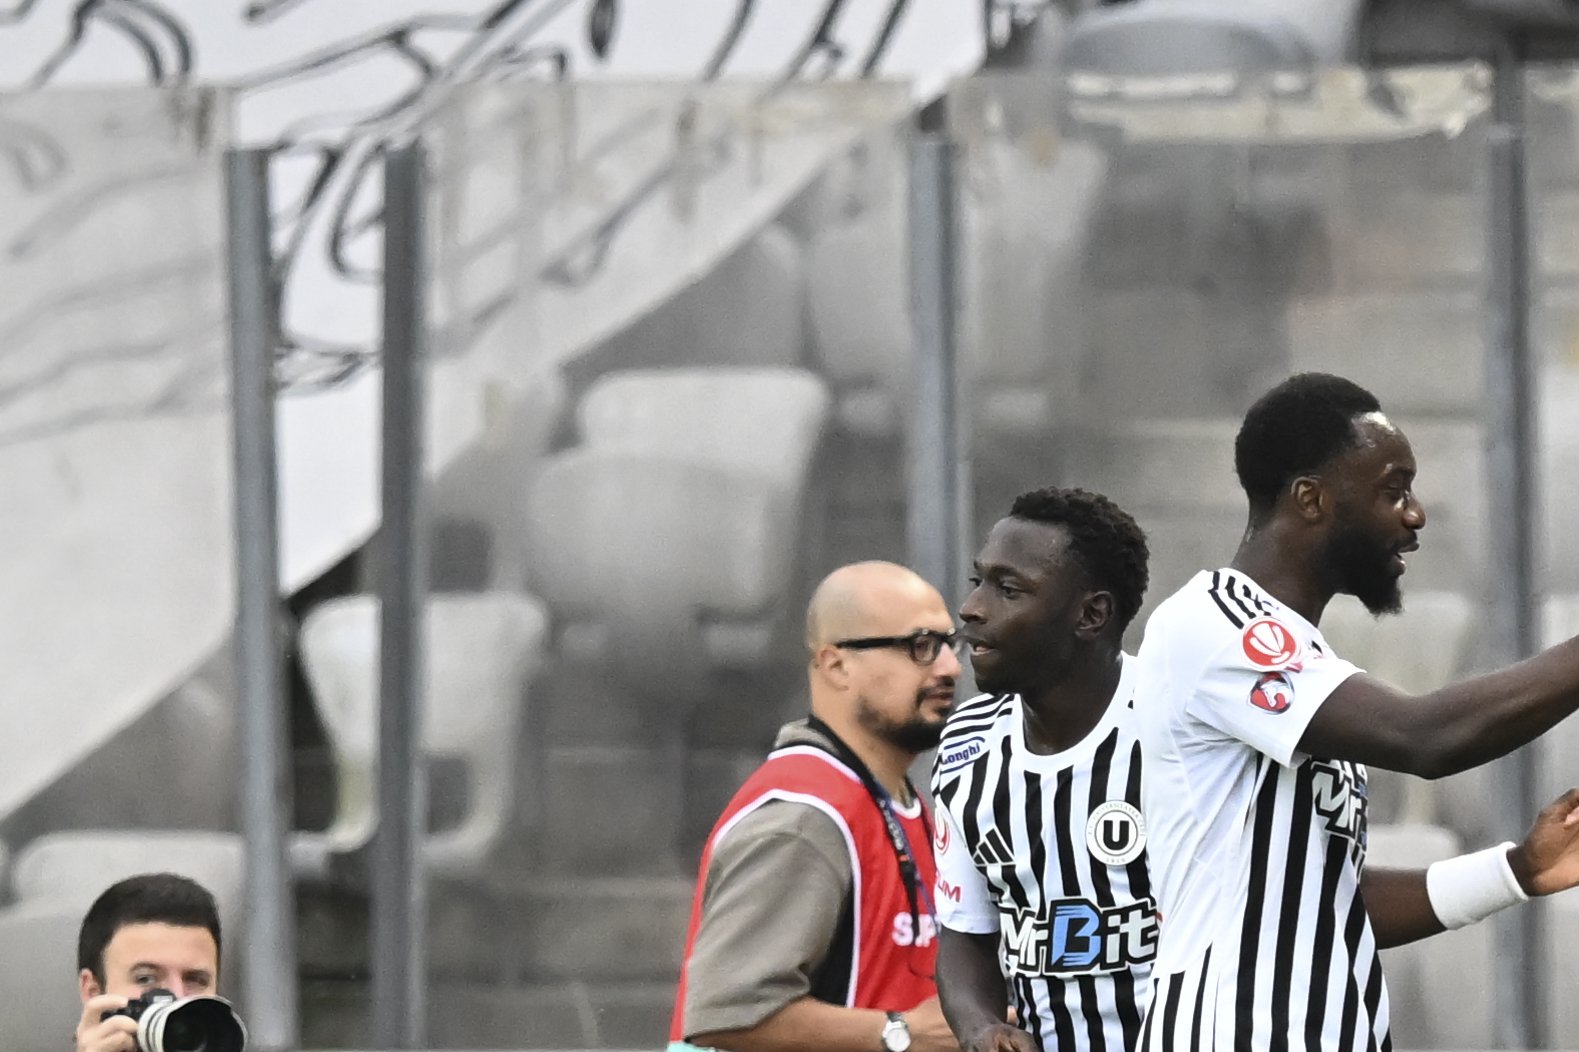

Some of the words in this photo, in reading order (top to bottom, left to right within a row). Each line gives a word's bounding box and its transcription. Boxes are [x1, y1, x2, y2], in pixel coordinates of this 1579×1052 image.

[942, 742, 981, 765] onghi
[1103, 820, 1130, 851] U
[999, 903, 1160, 967] MrBit
